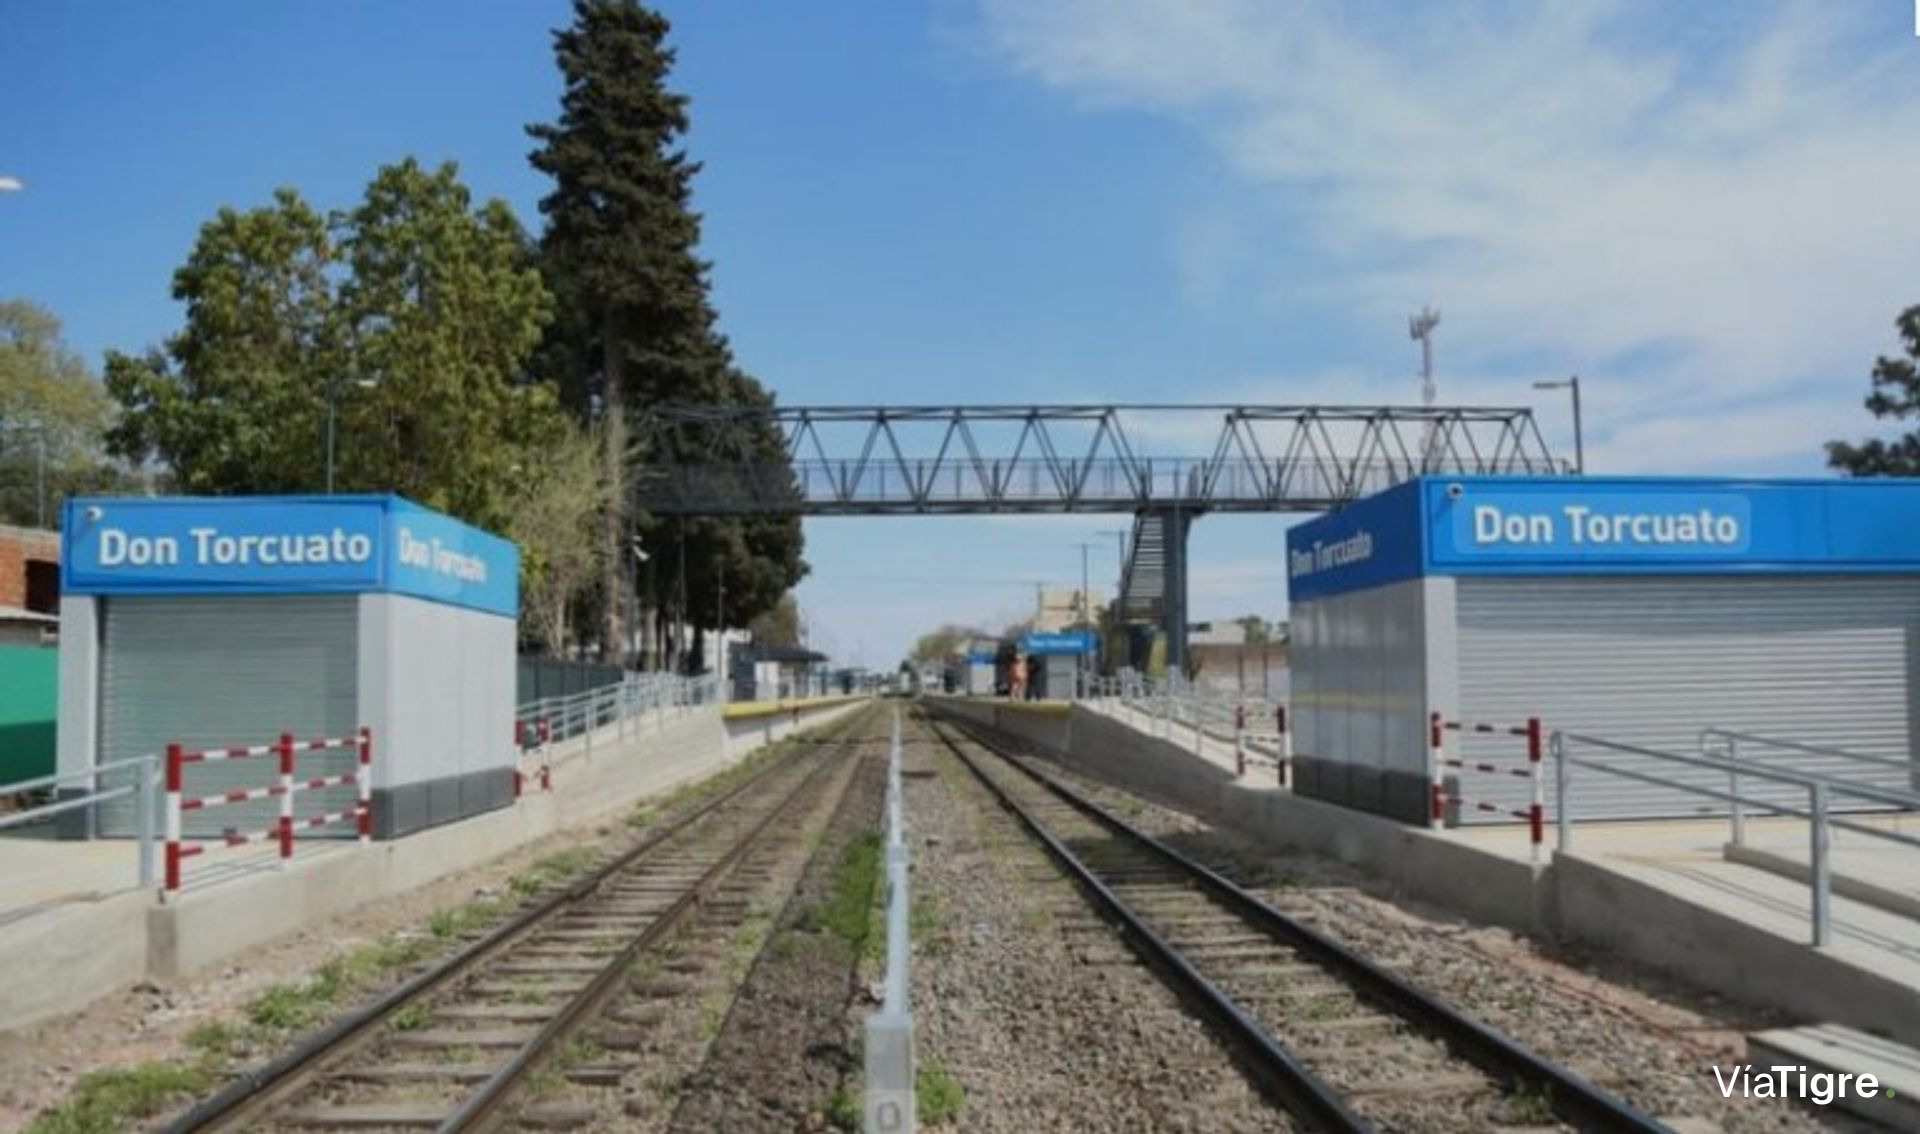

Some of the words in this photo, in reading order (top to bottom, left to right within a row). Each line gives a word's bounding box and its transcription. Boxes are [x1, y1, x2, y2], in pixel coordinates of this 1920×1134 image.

[1474, 505, 1554, 544] Don
[1563, 505, 1739, 544] Torcuato
[99, 528, 179, 566] Don
[190, 526, 372, 565] Torcuato
[398, 526, 430, 568] Don
